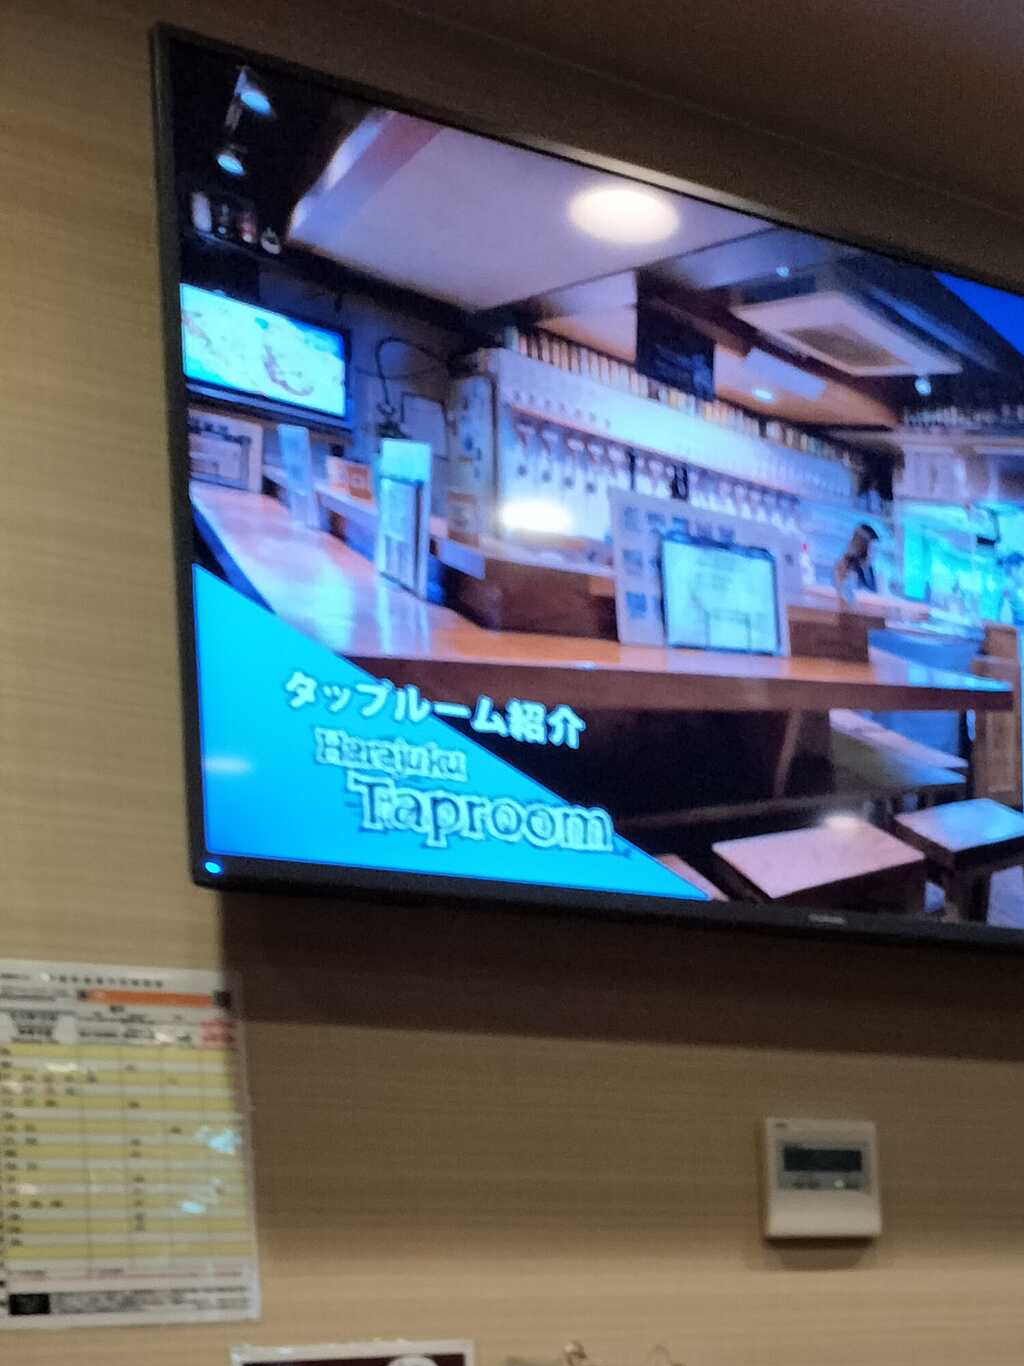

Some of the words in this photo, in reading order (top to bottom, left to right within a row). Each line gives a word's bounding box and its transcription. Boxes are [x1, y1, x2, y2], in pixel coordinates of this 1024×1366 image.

[285, 671, 587, 749] タップルーム紹介
[346, 771, 614, 850] Taproom
